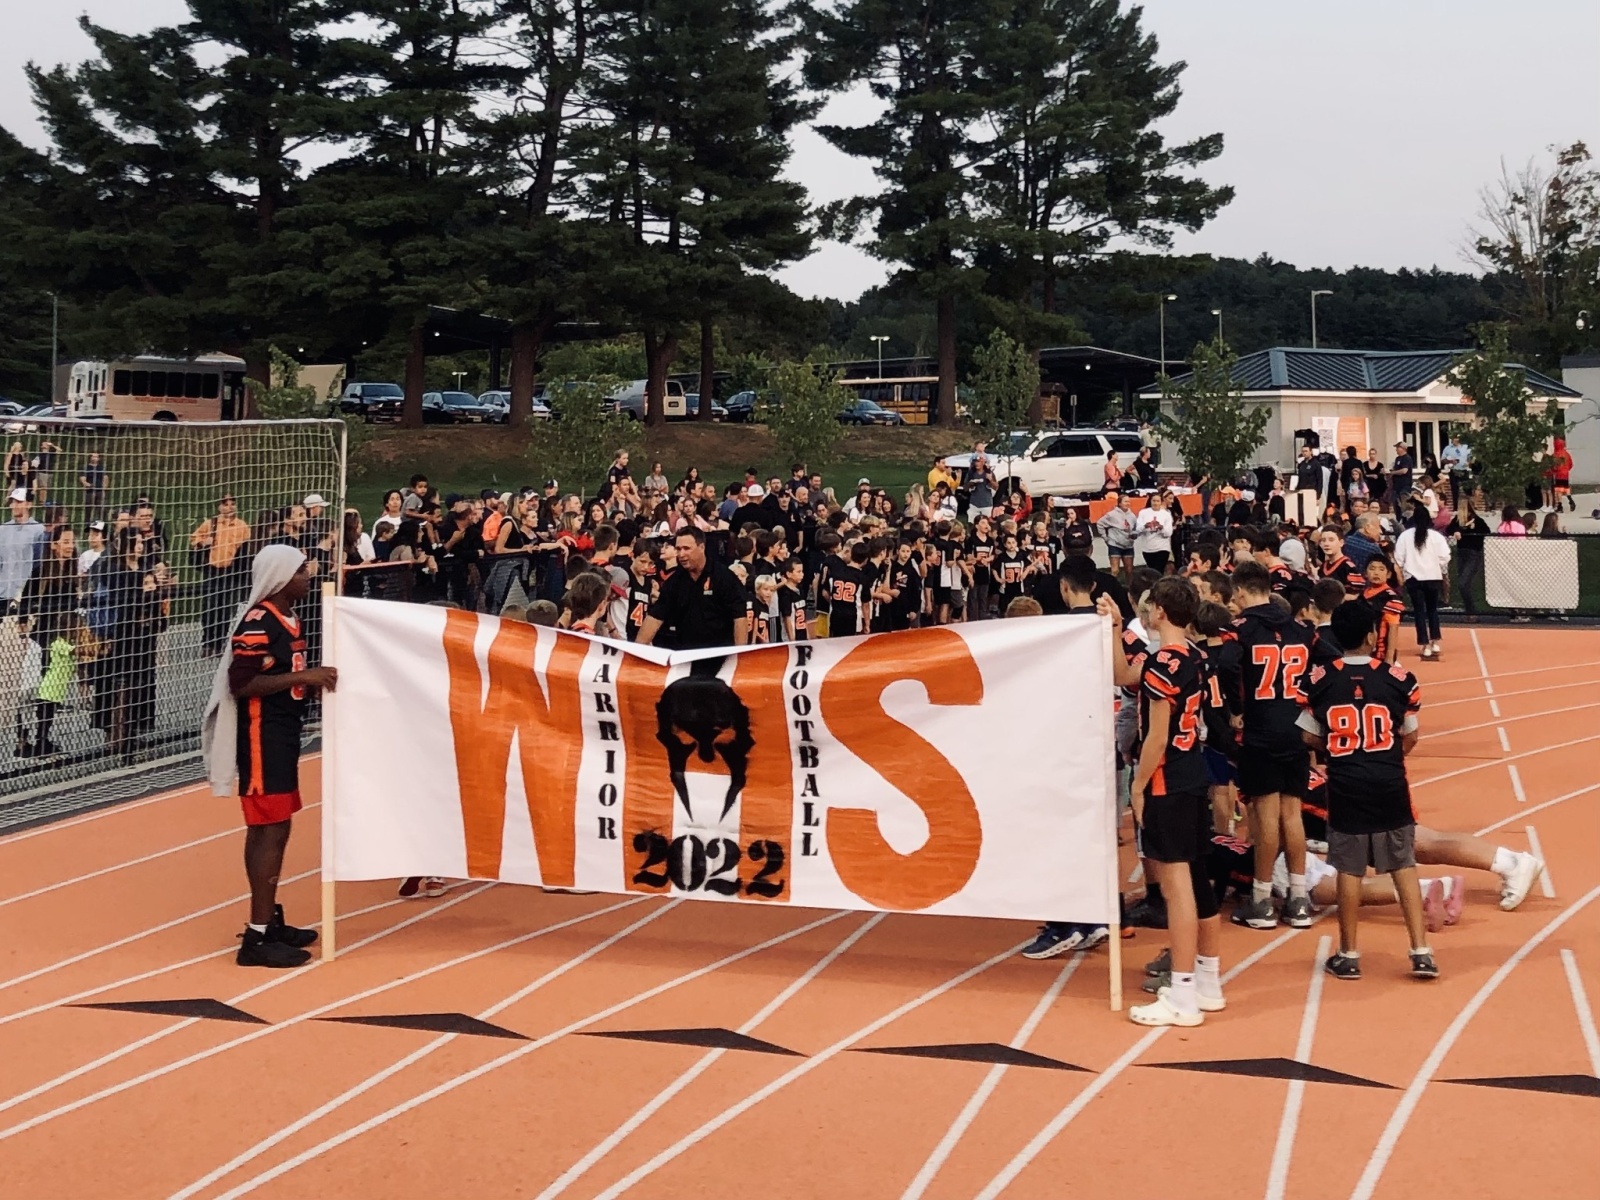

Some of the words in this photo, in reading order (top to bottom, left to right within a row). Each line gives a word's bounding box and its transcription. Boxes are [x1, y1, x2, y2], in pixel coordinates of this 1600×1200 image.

[833, 580, 856, 602] 32
[1252, 643, 1308, 699] 72
[592, 643, 621, 841] WARRIOR
[788, 644, 822, 857] FOOTBALL
[1326, 703, 1394, 757] 80
[632, 827, 785, 898] 2022
